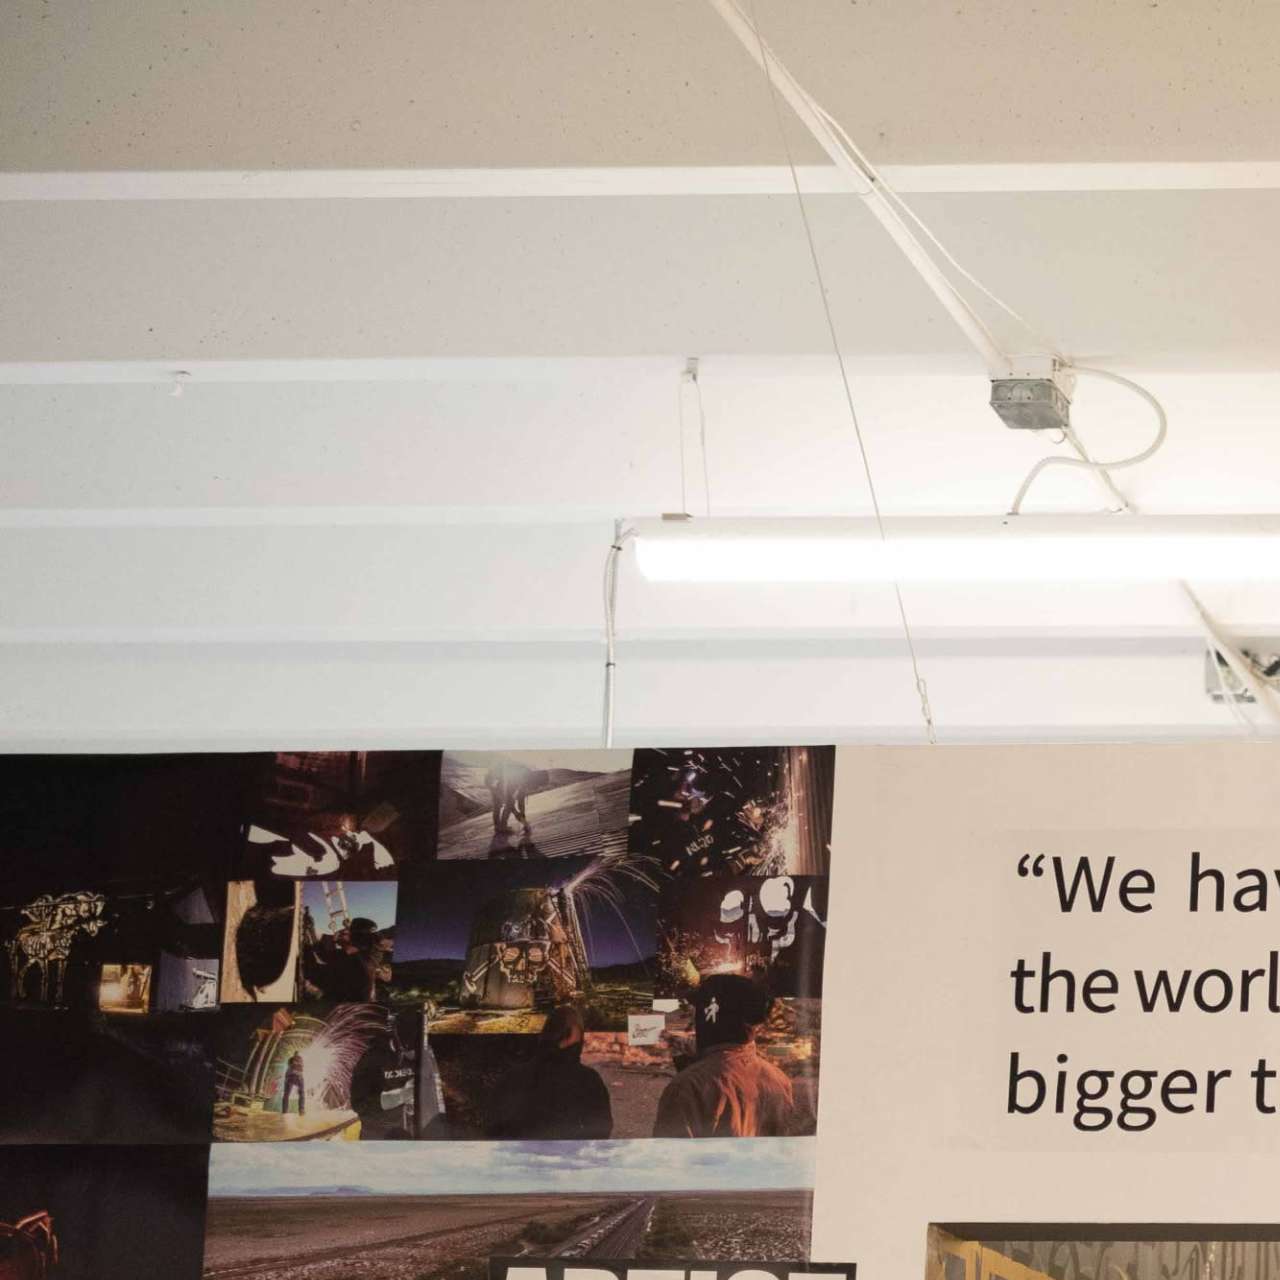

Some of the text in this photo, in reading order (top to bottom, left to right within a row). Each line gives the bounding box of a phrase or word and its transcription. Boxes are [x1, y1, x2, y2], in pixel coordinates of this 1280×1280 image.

[1018, 854, 1155, 913] “We
[1011, 952, 1118, 1013] the
[1008, 1052, 1231, 1131] bigger
